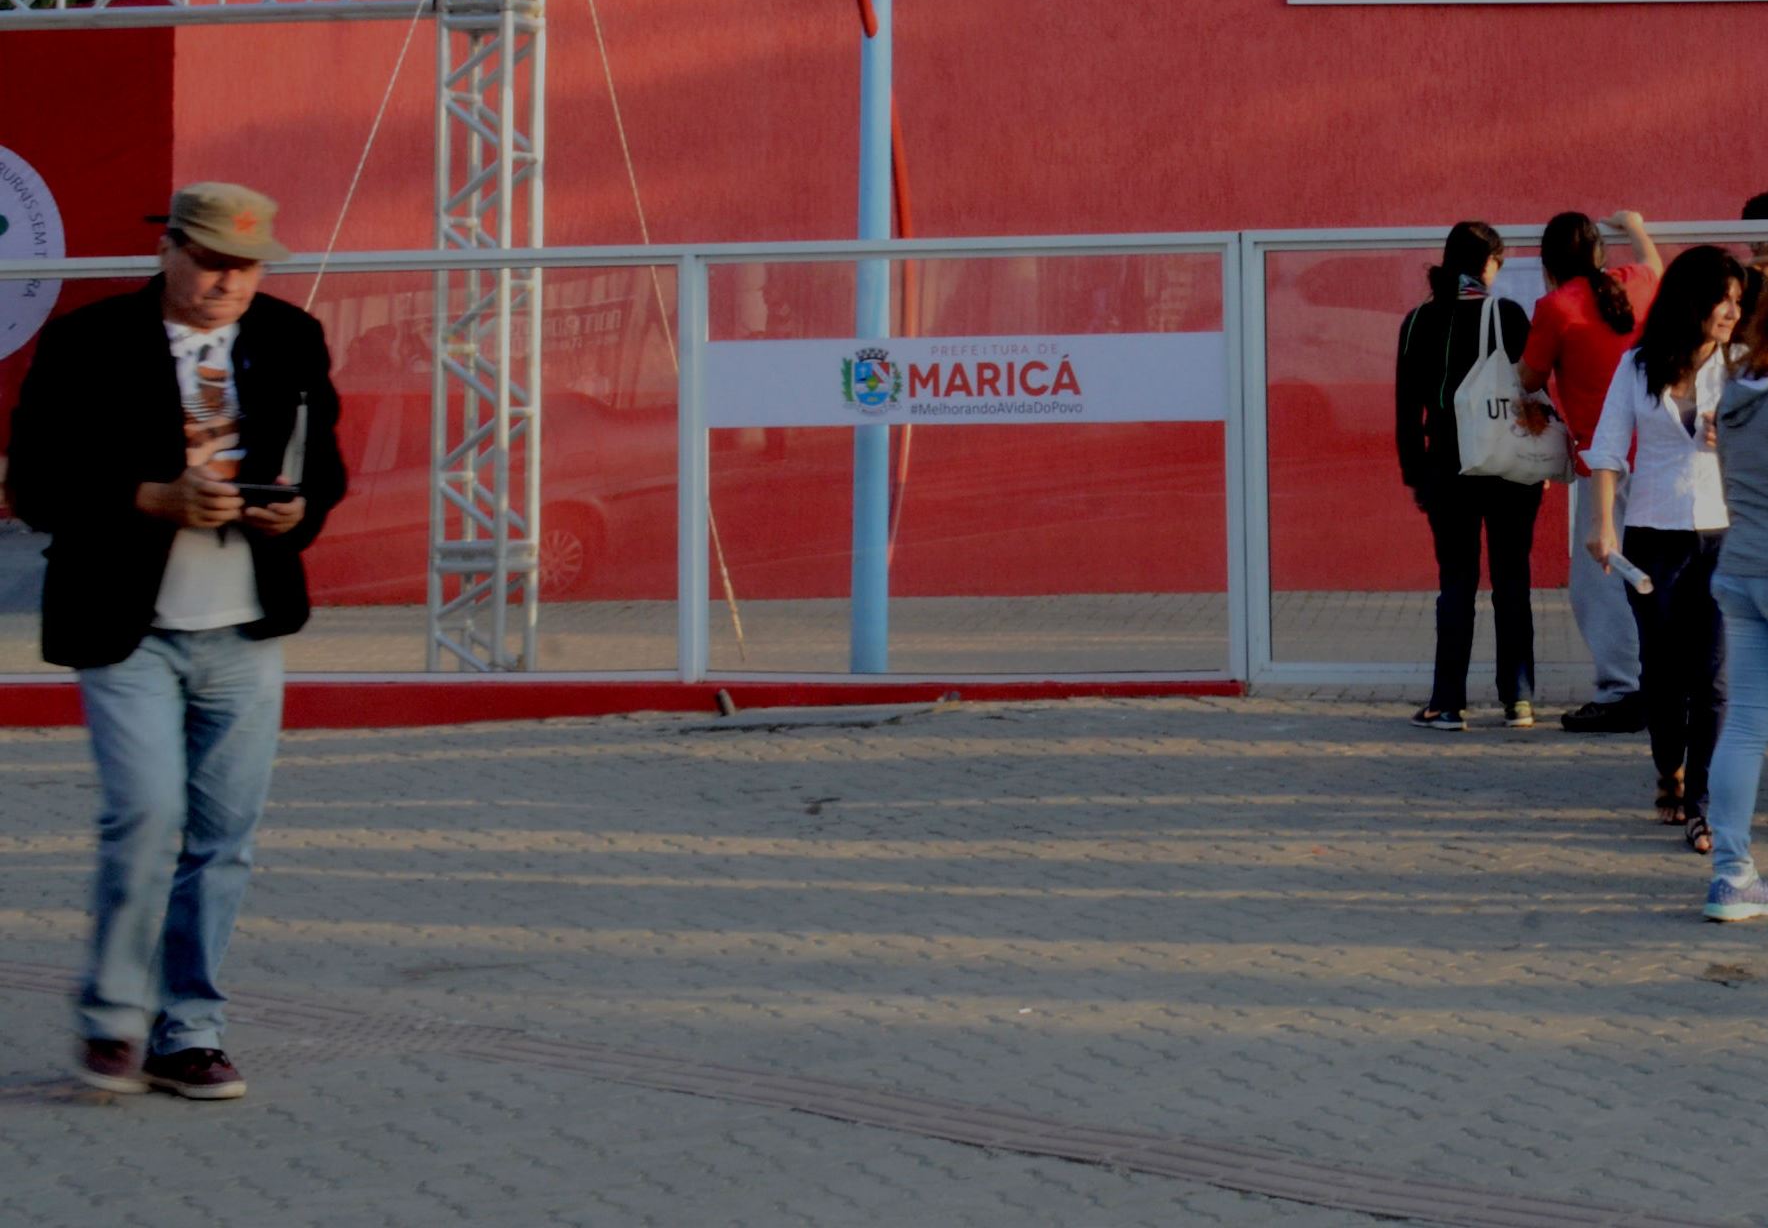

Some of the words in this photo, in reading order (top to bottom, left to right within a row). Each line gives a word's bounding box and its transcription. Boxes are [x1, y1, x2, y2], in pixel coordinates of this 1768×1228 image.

[931, 344, 1031, 356] PREFEITURA
[1038, 342, 1060, 355] DE
[908, 354, 1081, 399] MARICÁ
[910, 400, 1083, 417] #MelhorandoAVidaDoPovo
